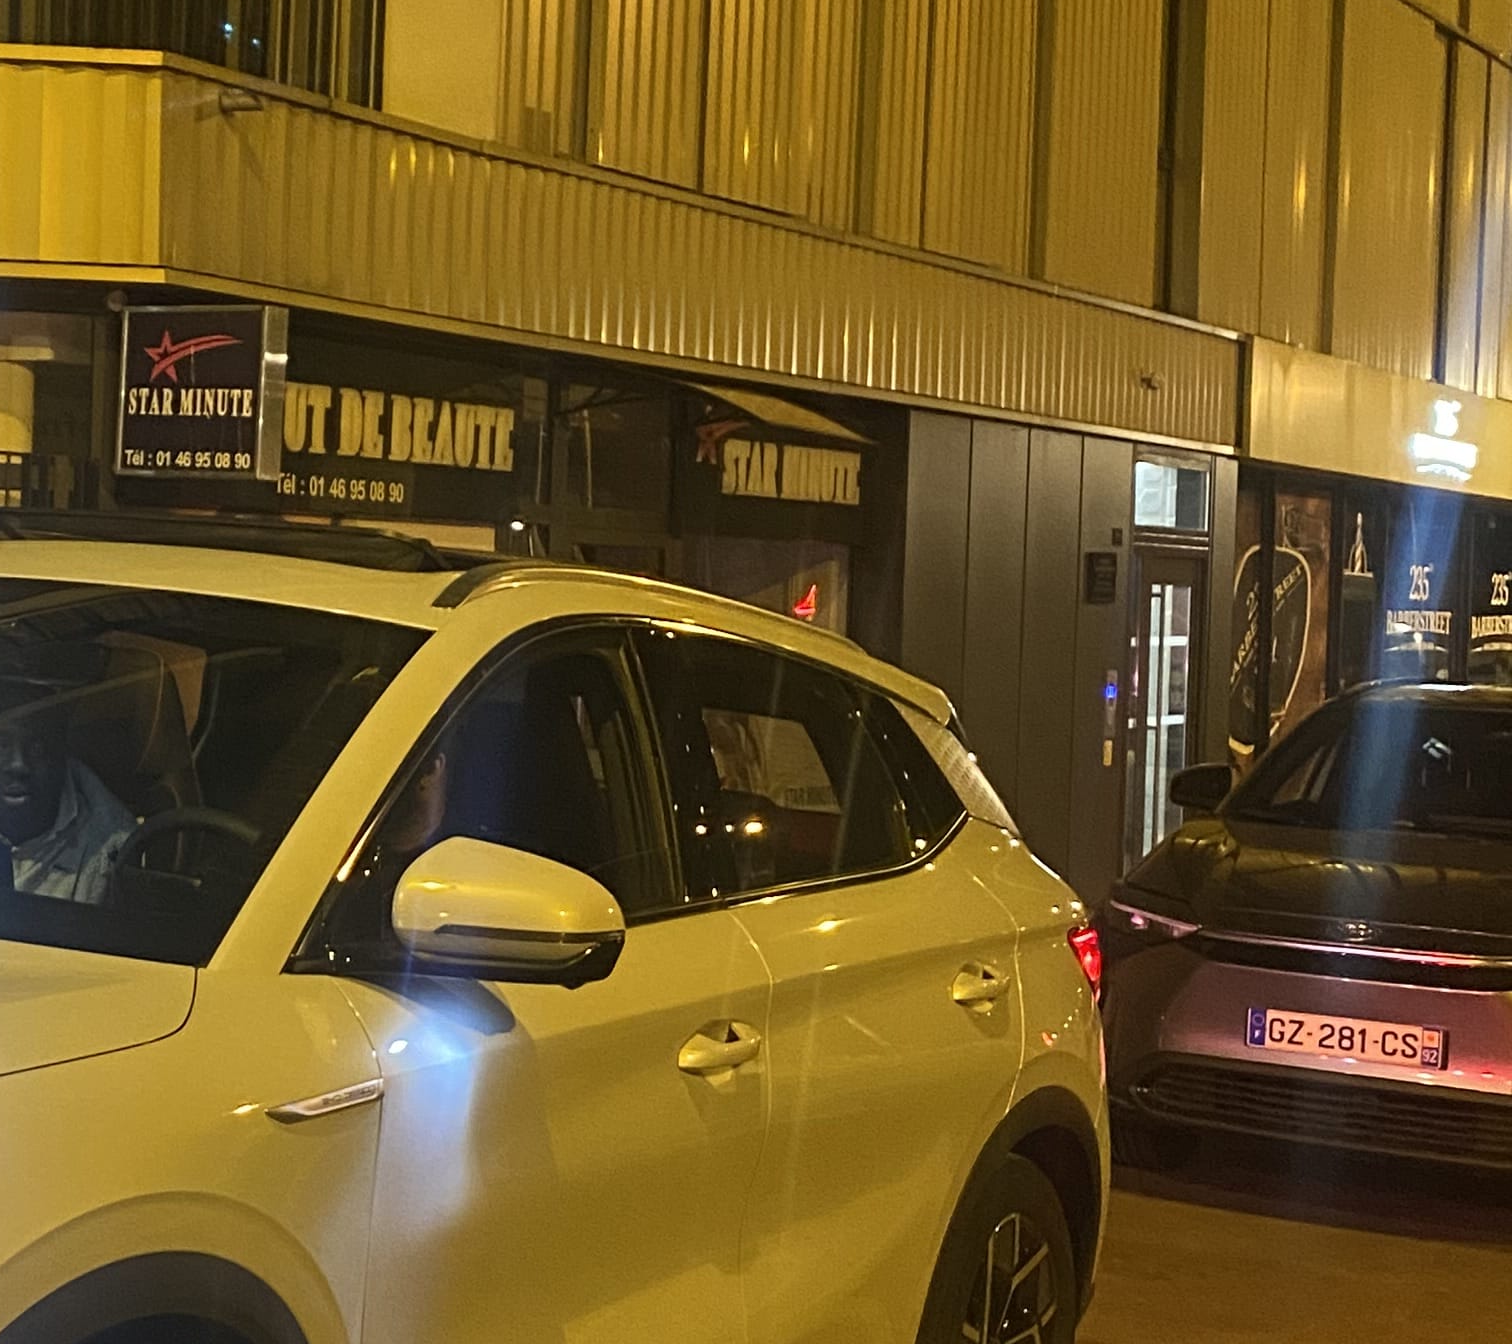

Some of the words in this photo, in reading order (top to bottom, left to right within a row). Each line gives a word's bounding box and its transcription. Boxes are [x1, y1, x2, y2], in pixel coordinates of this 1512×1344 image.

[128, 387, 174, 416] STAR
[178, 388, 254, 418] MINUTE
[337, 387, 385, 459] DE
[388, 394, 515, 472] BEAUTE
[156, 451, 171, 466] 01
[175, 451, 191, 467] 46
[194, 452, 211, 468] 95
[214, 453, 231, 469] 08
[234, 453, 251, 469] 90
[721, 438, 778, 498] STAR
[780, 445, 861, 505] MINUTE
[309, 475, 325, 497] 01
[329, 477, 346, 499] 46
[350, 479, 366, 500] 95
[369, 481, 385, 502] 08
[389, 482, 404, 504] 90
[1268, 1018, 1419, 1059] GZ-281-CS
[1421, 1047, 1438, 1065] 92
